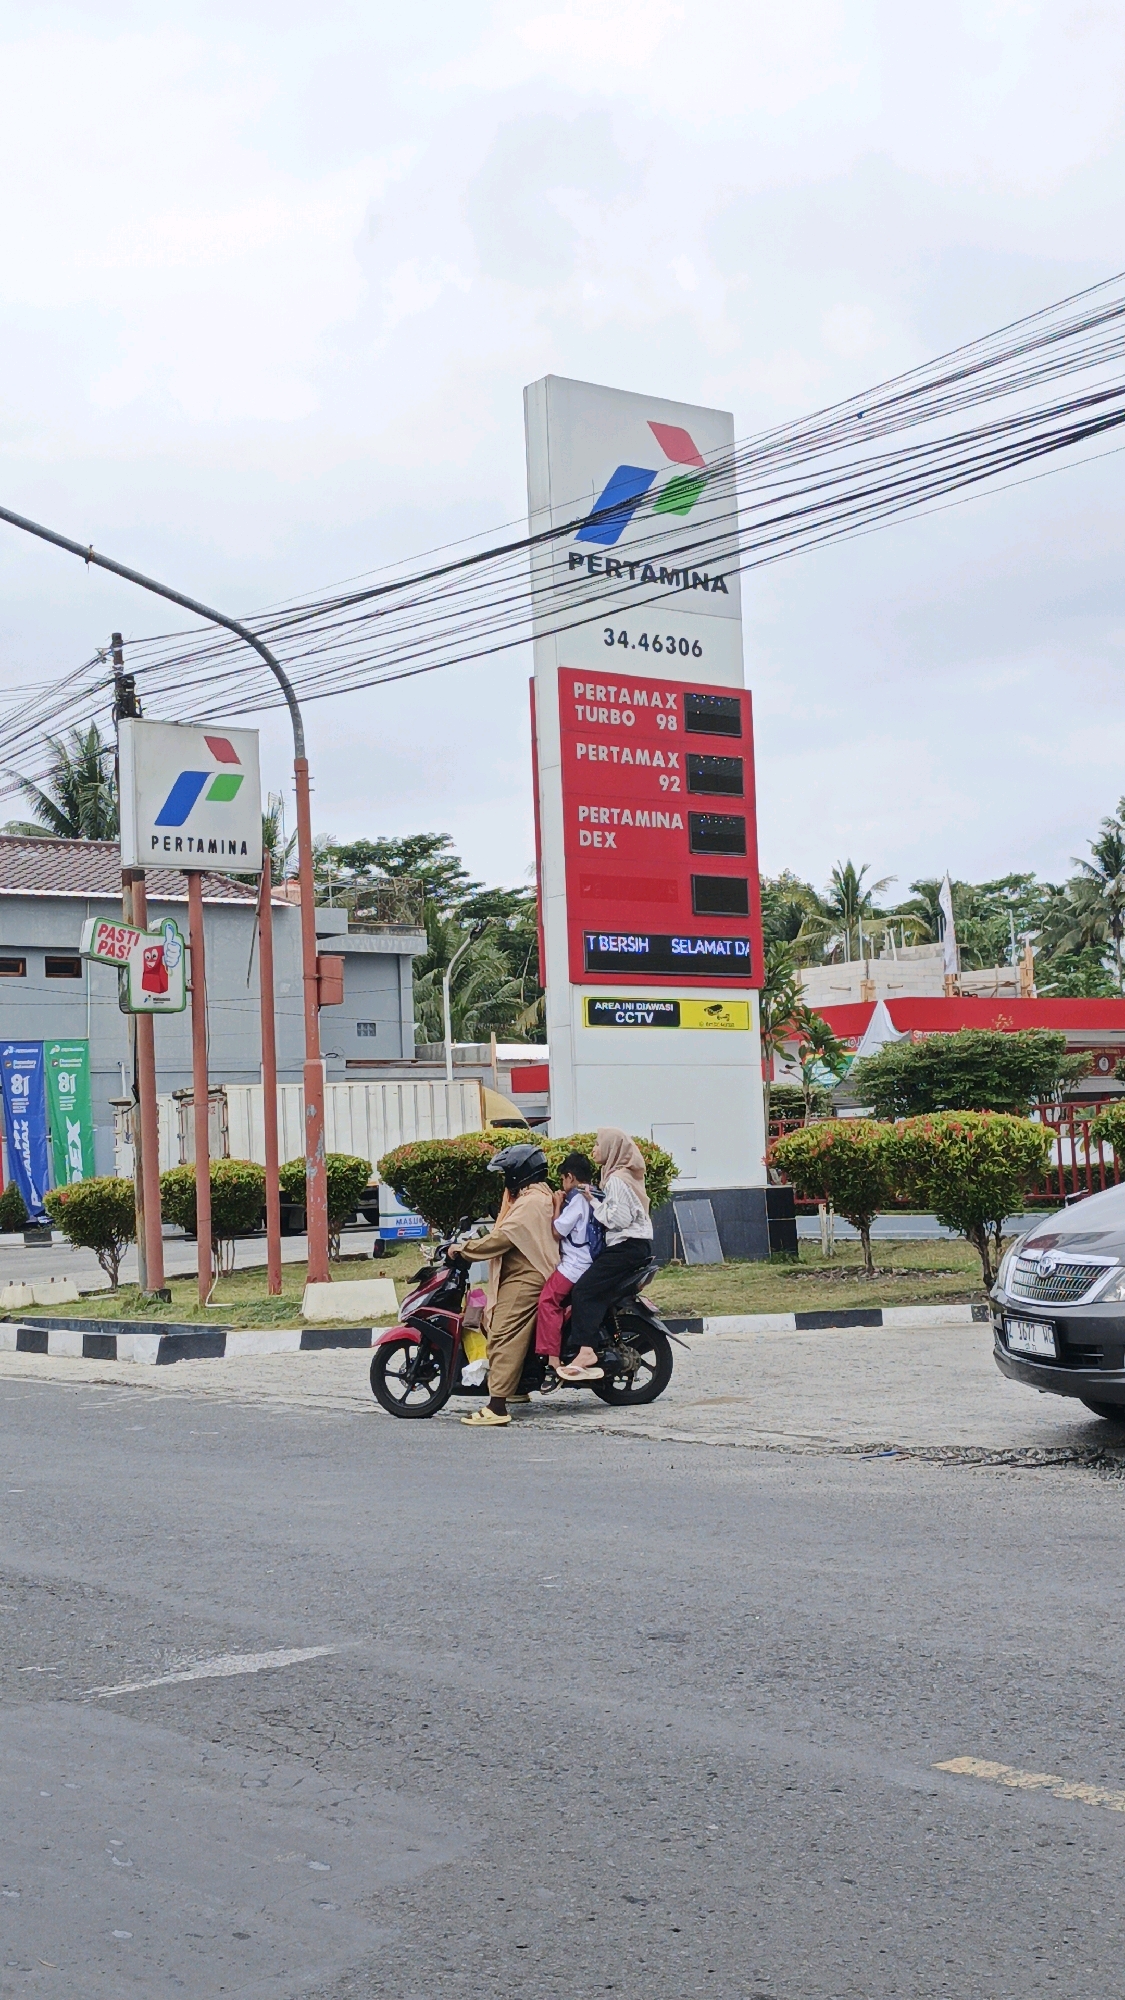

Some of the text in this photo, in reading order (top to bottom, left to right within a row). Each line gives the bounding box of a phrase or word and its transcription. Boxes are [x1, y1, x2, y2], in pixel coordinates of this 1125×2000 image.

[568, 551, 729, 595] PERTAMINA
[603, 627, 703, 658] 34.46306
[573, 681, 678, 710] PERTAMAX
[575, 704, 678, 731] TURBO 98
[576, 742, 680, 768] PERTAMAX
[659, 774, 681, 792] 92
[578, 805, 684, 829] PERTAMINA
[151, 835, 248, 855] PERTAMINA
[579, 829, 617, 848] DEX
[97, 923, 141, 947] PASTI
[599, 935, 649, 953] BERSIH
[671, 938, 732, 956] SELAMAT
[97, 940, 131, 961] PAS!
[594, 1001, 621, 1011] AREA
[622, 1002, 634, 1012] INI
[615, 1011, 654, 1024] CCTV
